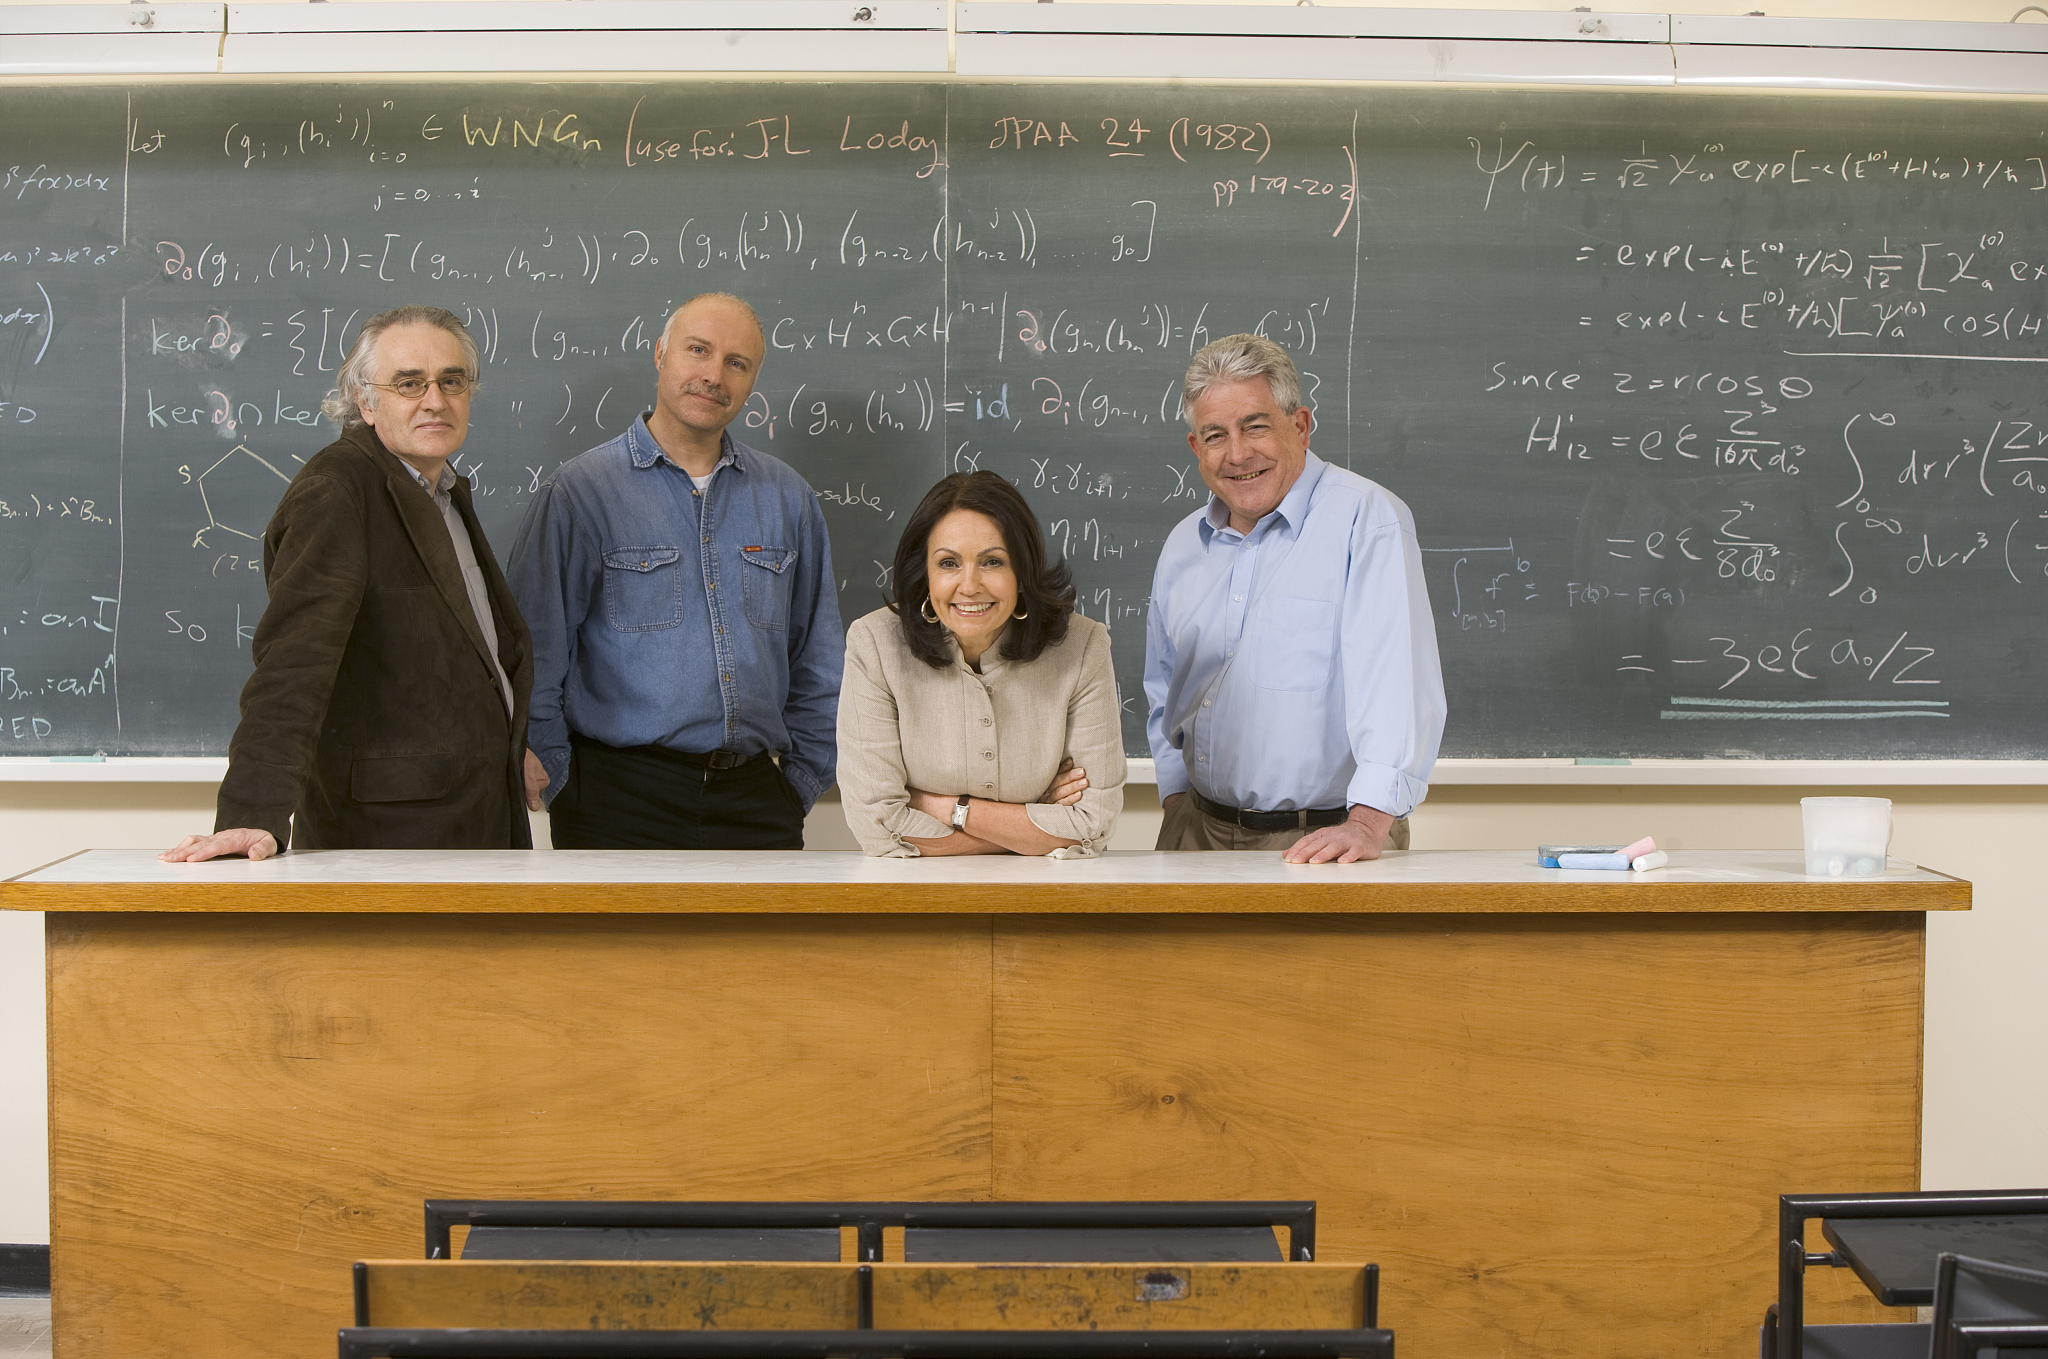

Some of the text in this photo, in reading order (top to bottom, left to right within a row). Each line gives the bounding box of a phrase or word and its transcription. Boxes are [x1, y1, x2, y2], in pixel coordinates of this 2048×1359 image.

[131, 118, 167, 154] Let
[840, 114, 949, 178] Loday
[1100, 118, 1151, 147] 24
[1169, 116, 1271, 165] (1982)
[1213, 179, 1239, 208] pp
[1486, 363, 1582, 393] Since
